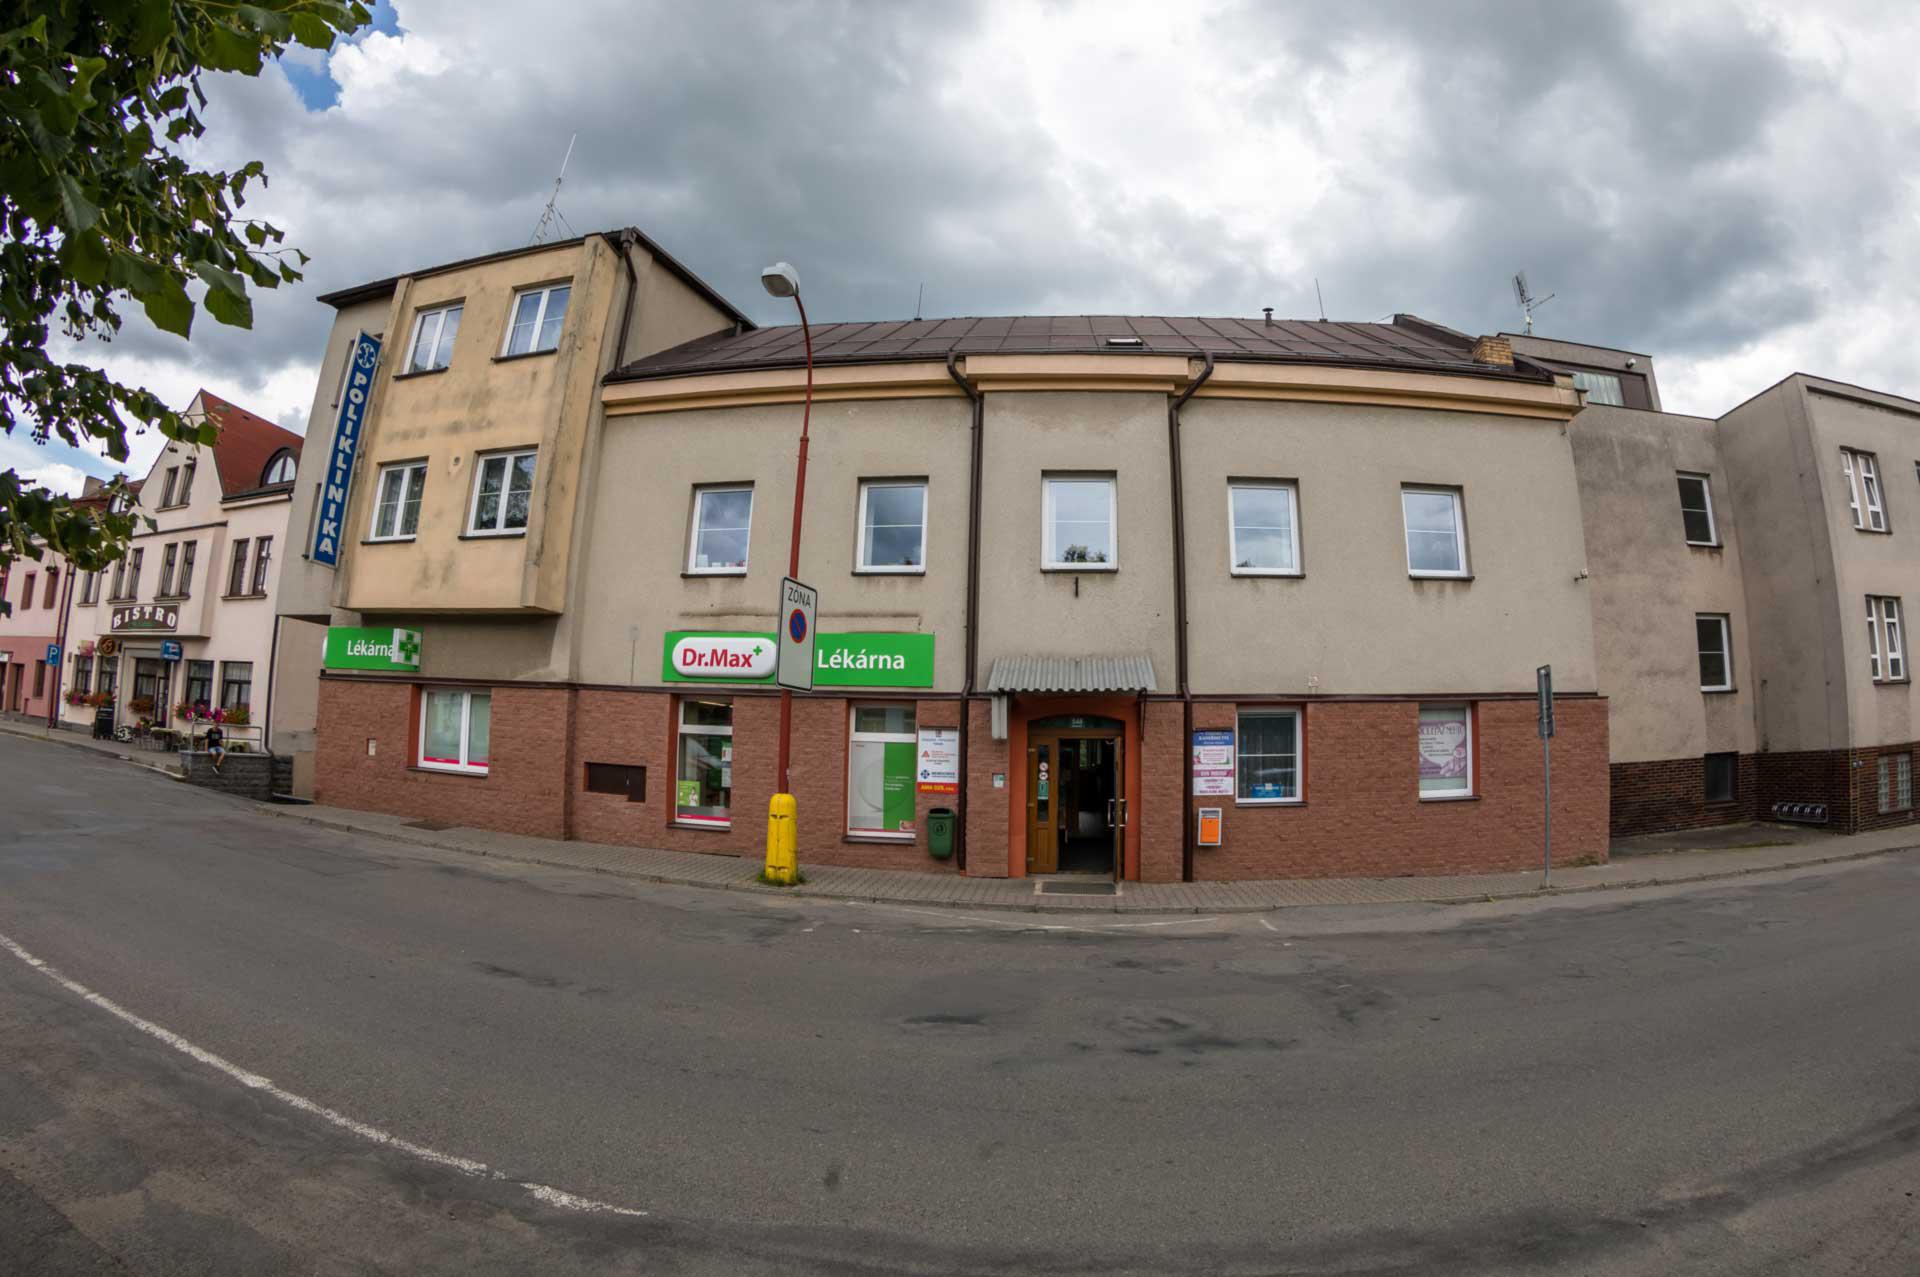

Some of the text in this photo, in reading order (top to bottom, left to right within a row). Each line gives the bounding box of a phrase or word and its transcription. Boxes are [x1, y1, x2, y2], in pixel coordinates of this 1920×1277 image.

[319, 371, 367, 555] POLIKLINIKA
[787, 586, 811, 608] ZÓNA
[113, 606, 176, 628] BISTRO
[50, 647, 58, 658] P
[347, 639, 394, 657] Lékárna
[682, 648, 753, 668] Dr.Max
[817, 648, 905, 669] Lékárna
